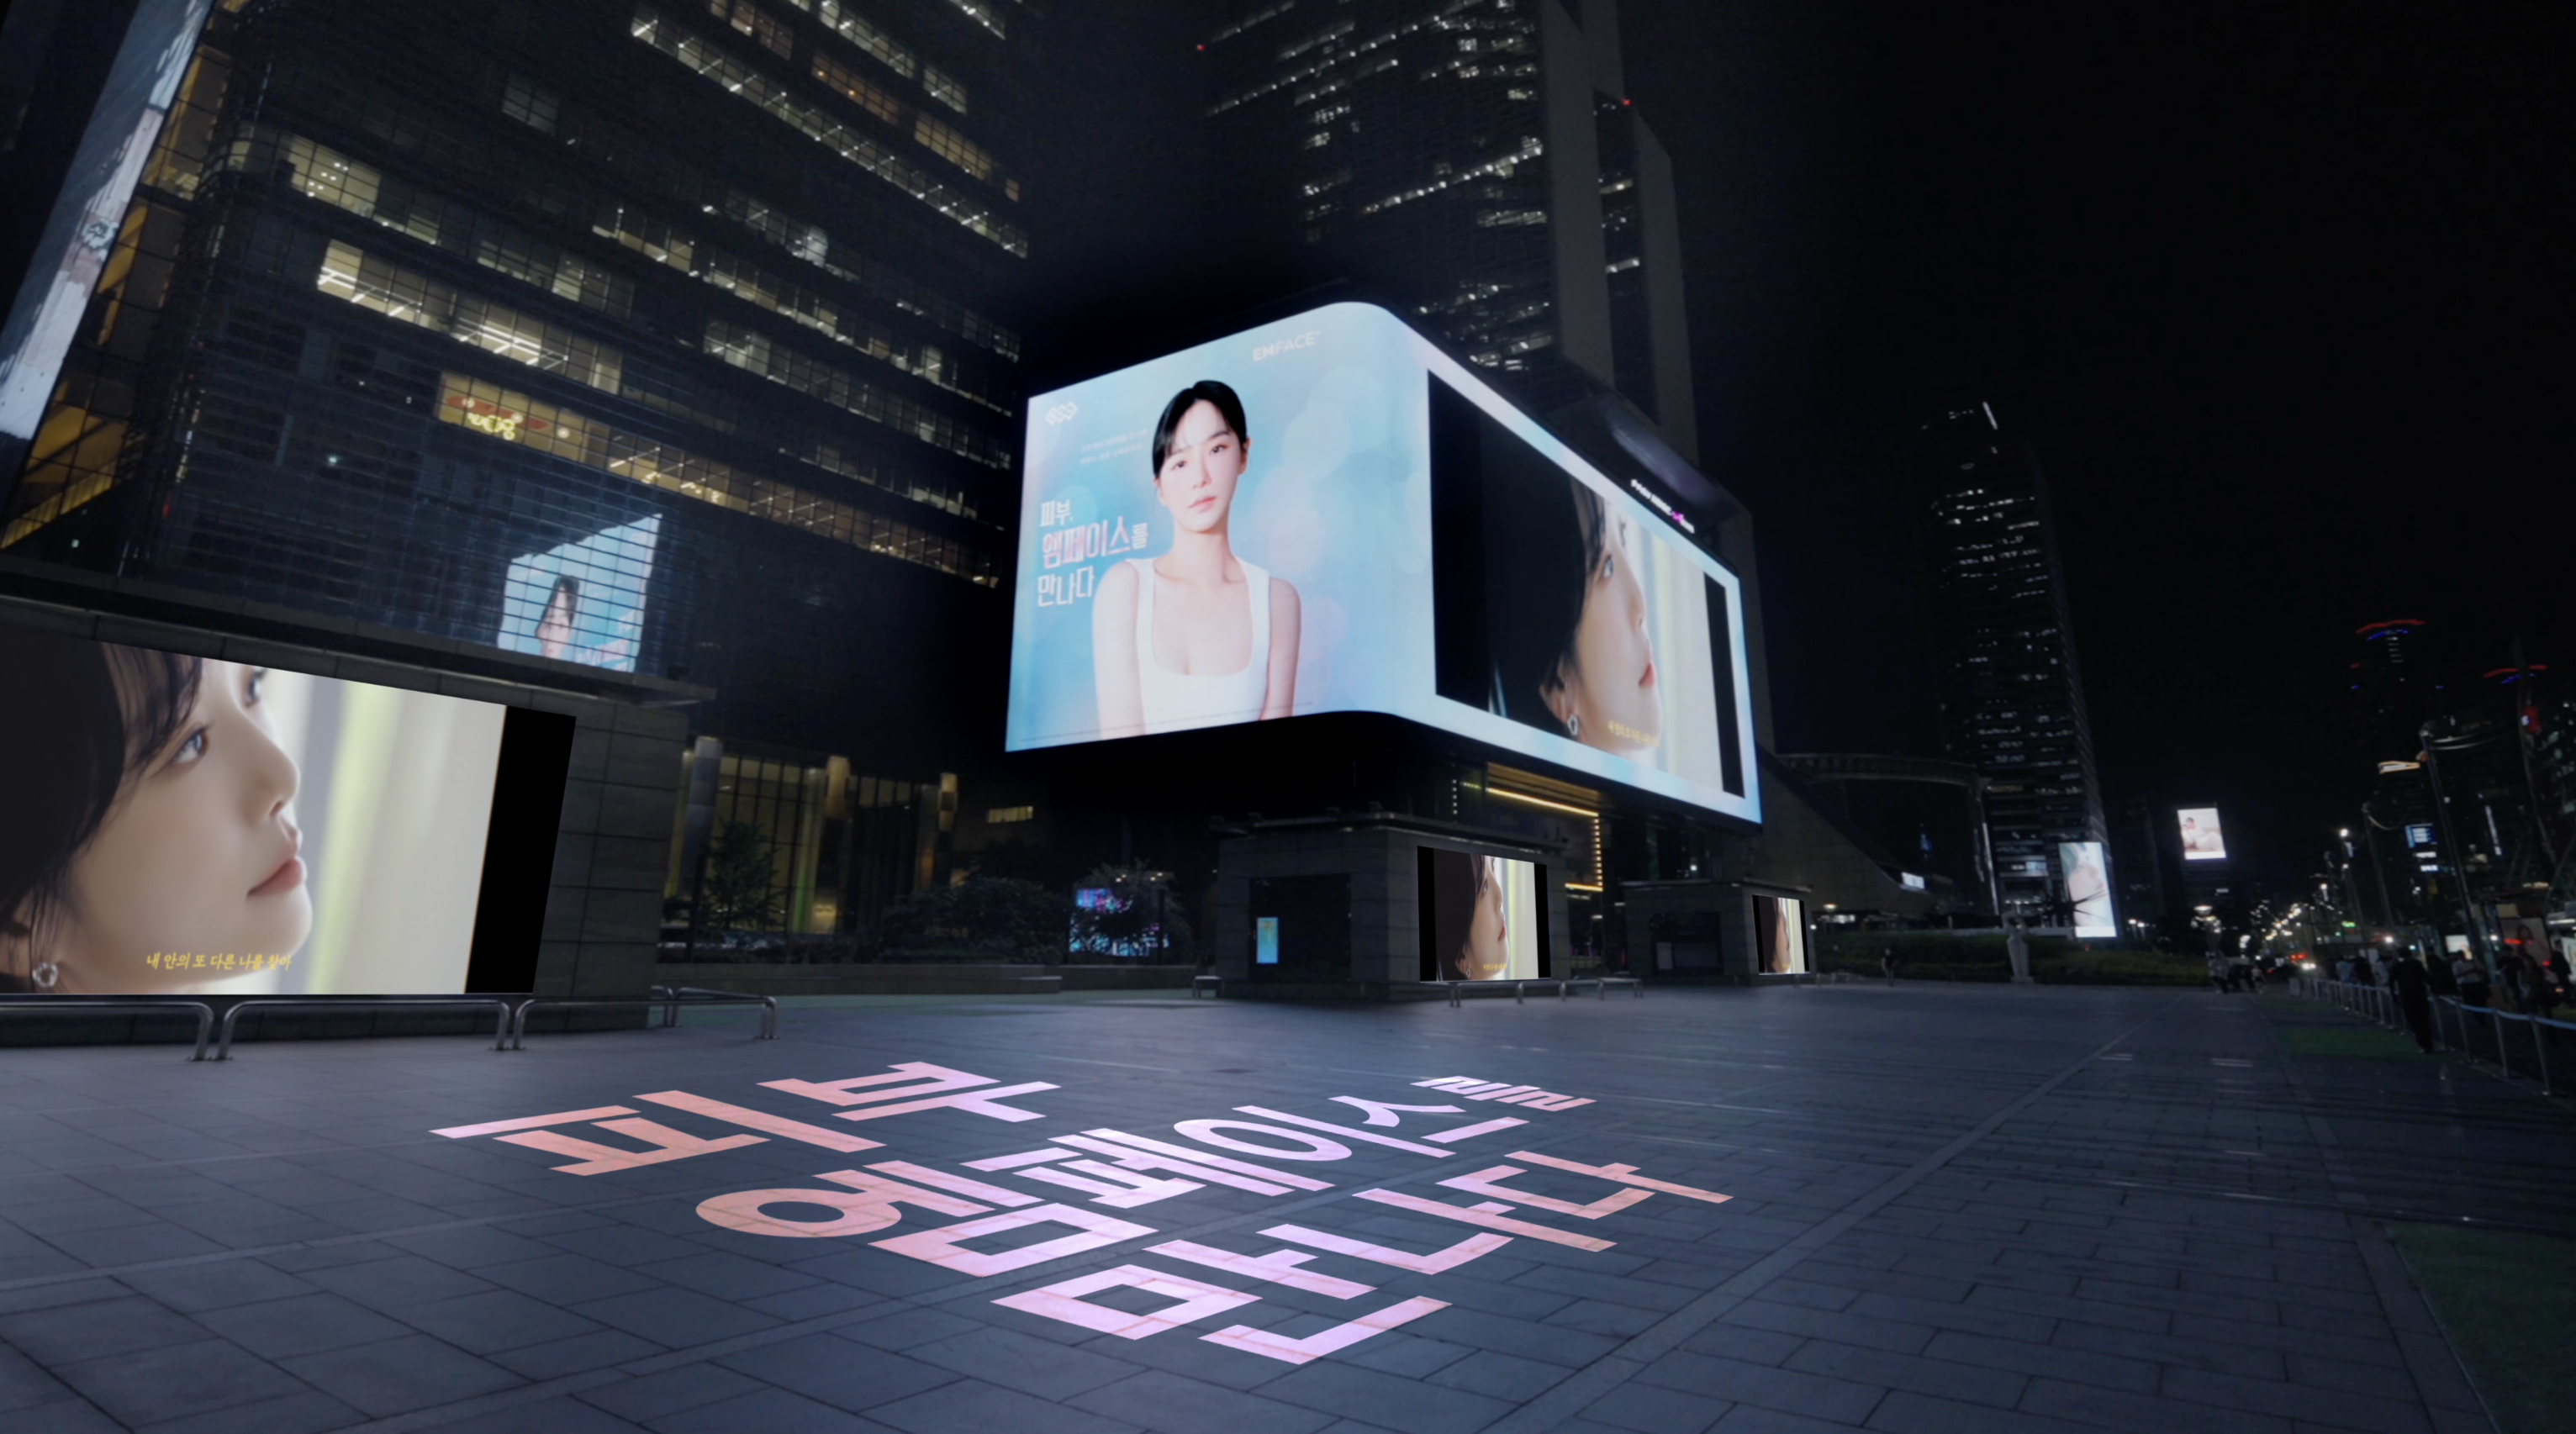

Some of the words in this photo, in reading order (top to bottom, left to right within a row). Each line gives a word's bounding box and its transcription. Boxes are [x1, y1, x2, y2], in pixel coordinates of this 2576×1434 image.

[1043, 515, 1148, 569] 엠페이스를
[1037, 566, 1095, 607] 만나다
[146, 952, 161, 969] 내
[164, 952, 191, 969] 안의
[193, 955, 206, 967] 또
[210, 953, 235, 970] 다른
[239, 953, 264, 971] 나를
[267, 954, 292, 971] 찾아
[430, 1062, 1061, 1176] 피부
[697, 1076, 1596, 1278] 엠페이스를
[991, 1151, 1733, 1365] 만나다
